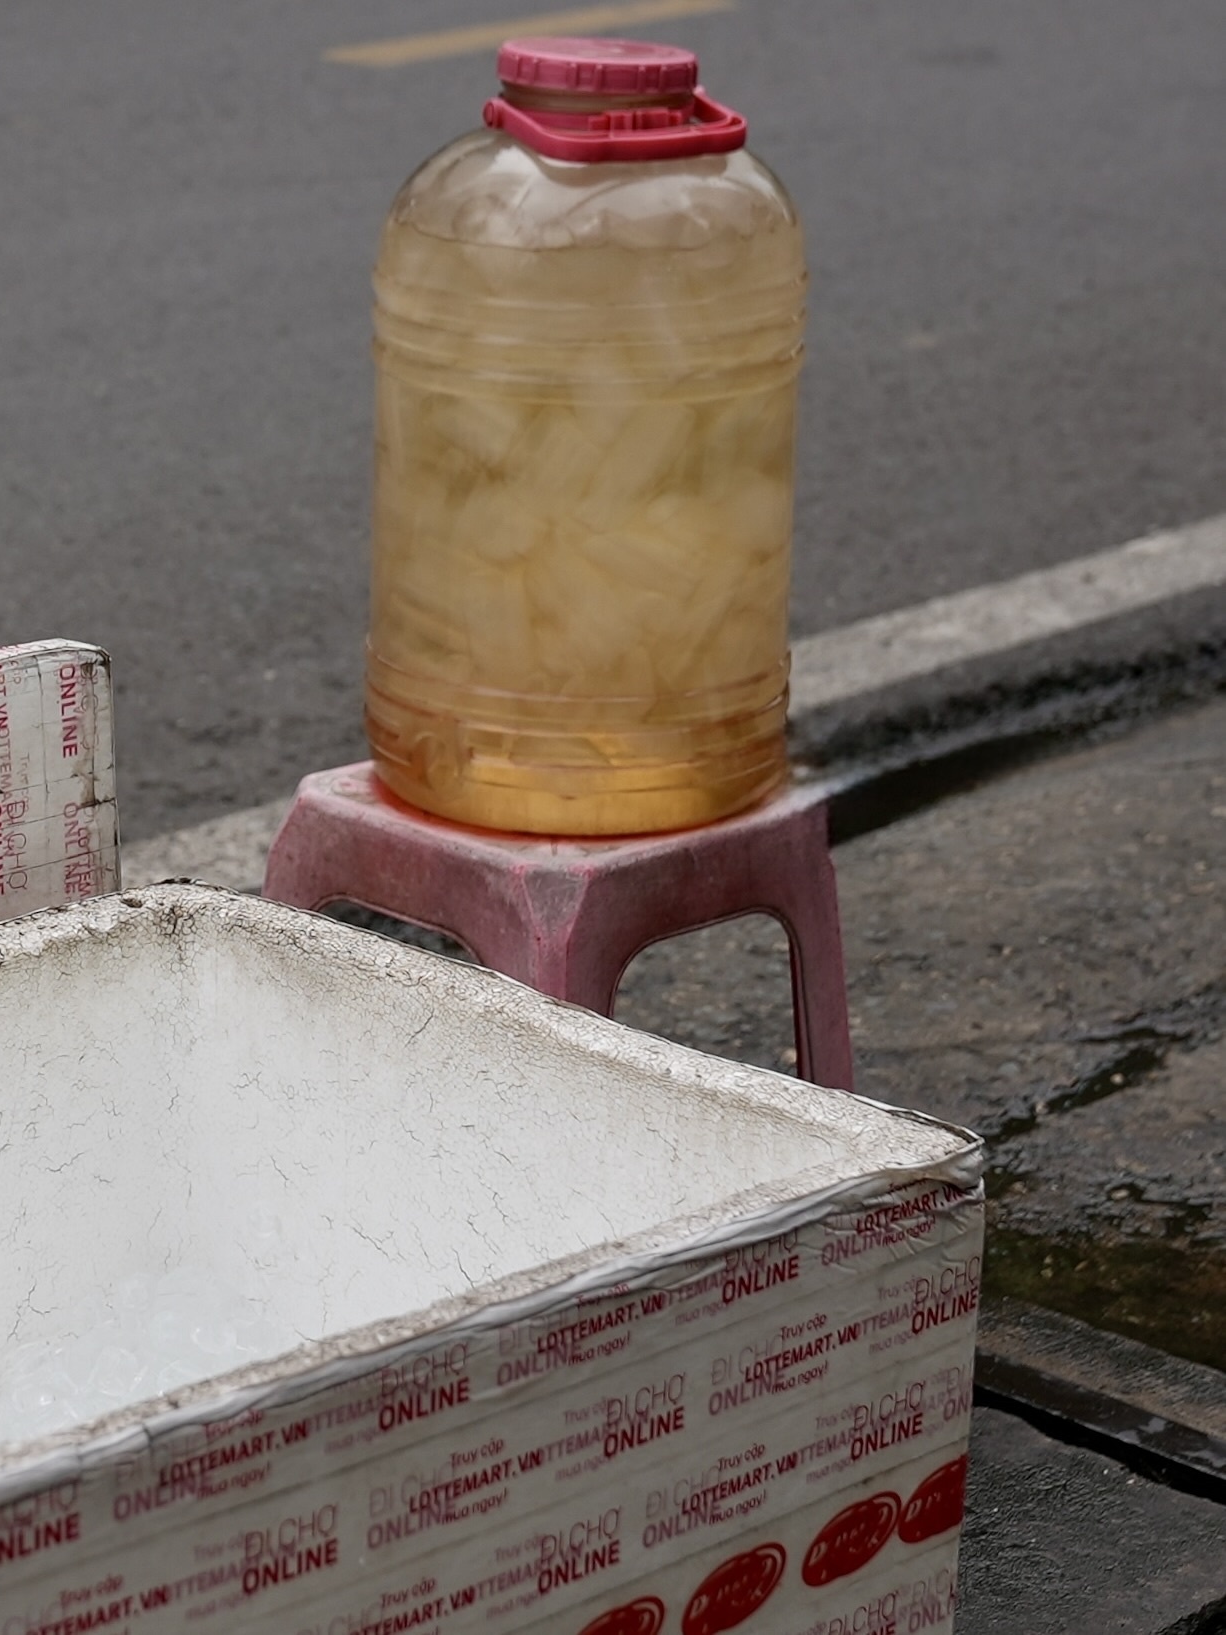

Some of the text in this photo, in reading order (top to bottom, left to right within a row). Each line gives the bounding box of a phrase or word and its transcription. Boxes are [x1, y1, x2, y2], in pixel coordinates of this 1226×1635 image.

[59, 664, 79, 758] ONLINE
[722, 1255, 800, 1305] ONLINE
[537, 1292, 663, 1354] LOTTEMART.VN
[912, 1286, 979, 1335] ONLINE
[744, 1325, 858, 1383] LOTTEMART.VN
[378, 1376, 470, 1431] ONLINE
[604, 1406, 685, 1459] ONLINE
[851, 1412, 923, 1461] ONLINE
[409, 1449, 541, 1513] LOTTEMART.VN
[681, 1451, 798, 1516] LOTTEMART.VN
[242, 1538, 339, 1596] ONLINE
[538, 1539, 620, 1595] ONLINE
